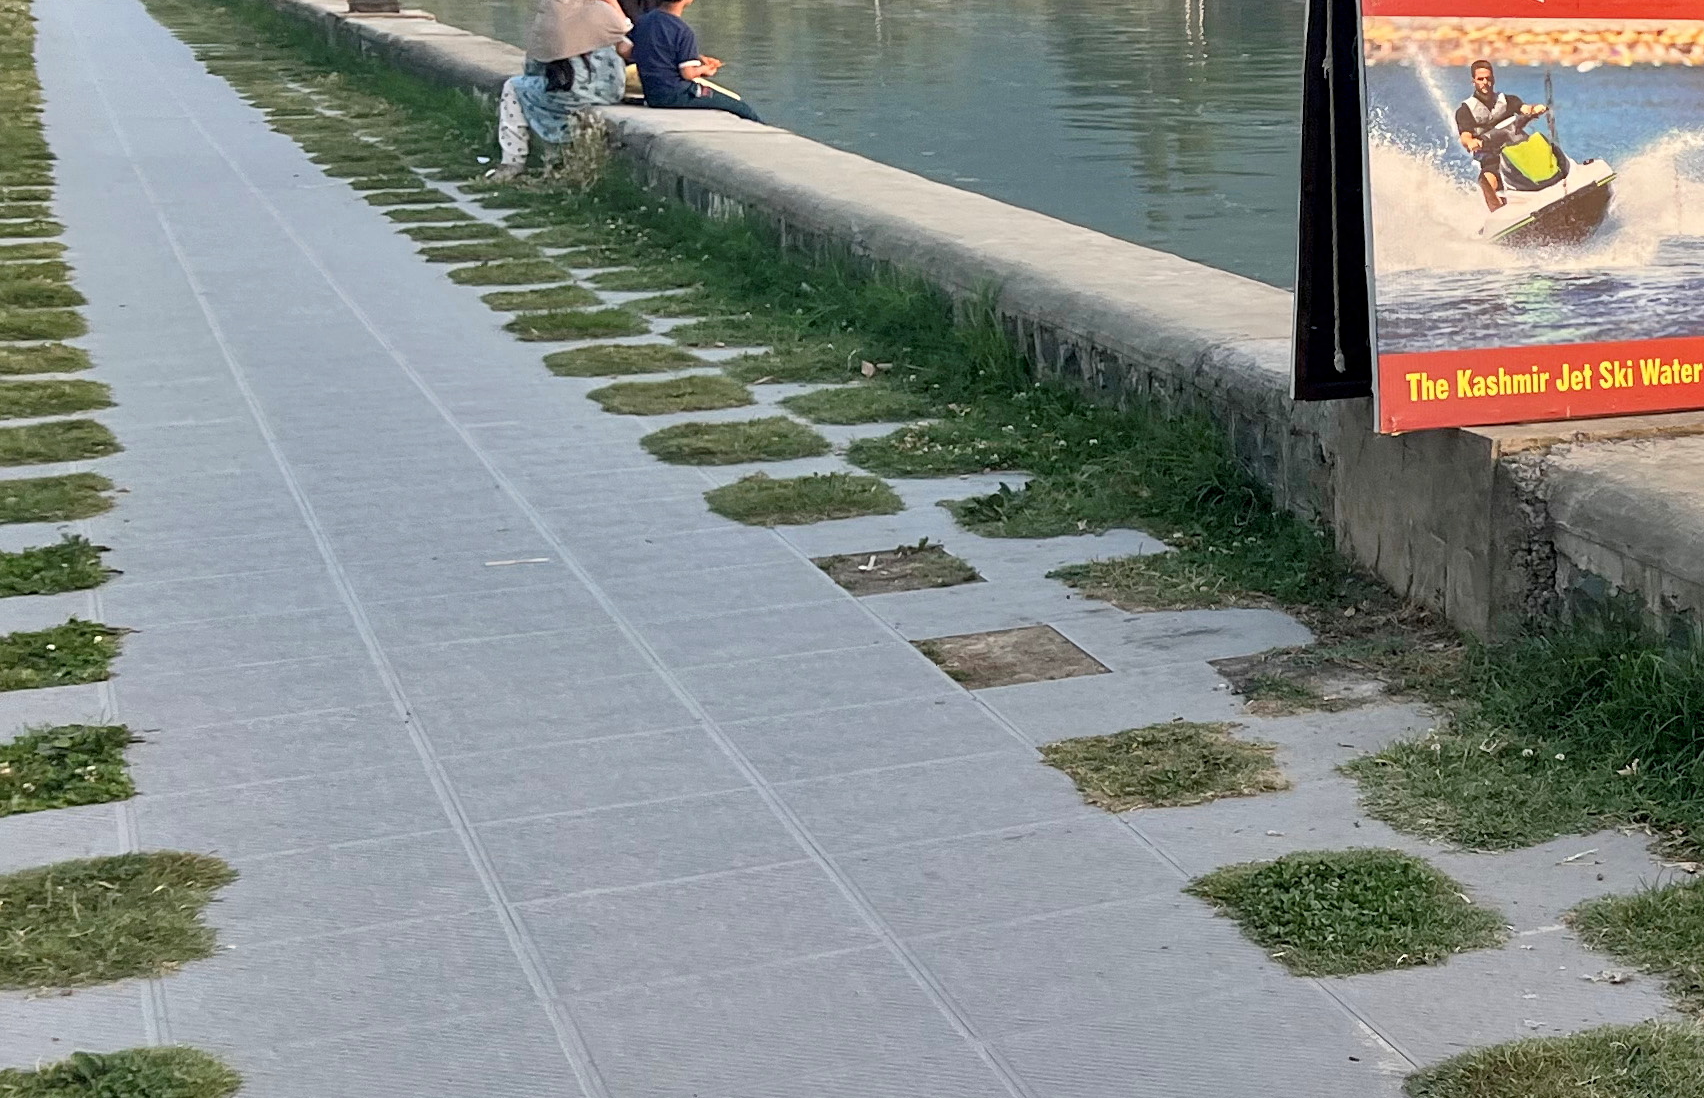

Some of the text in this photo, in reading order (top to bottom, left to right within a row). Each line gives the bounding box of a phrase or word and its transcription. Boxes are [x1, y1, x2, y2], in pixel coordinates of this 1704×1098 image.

[1405, 371, 1450, 402] The
[1456, 365, 1551, 398] Kashmir
[1555, 363, 1593, 392] Jet
[1598, 359, 1634, 389] Ski
[1639, 357, 1703, 387] Water
